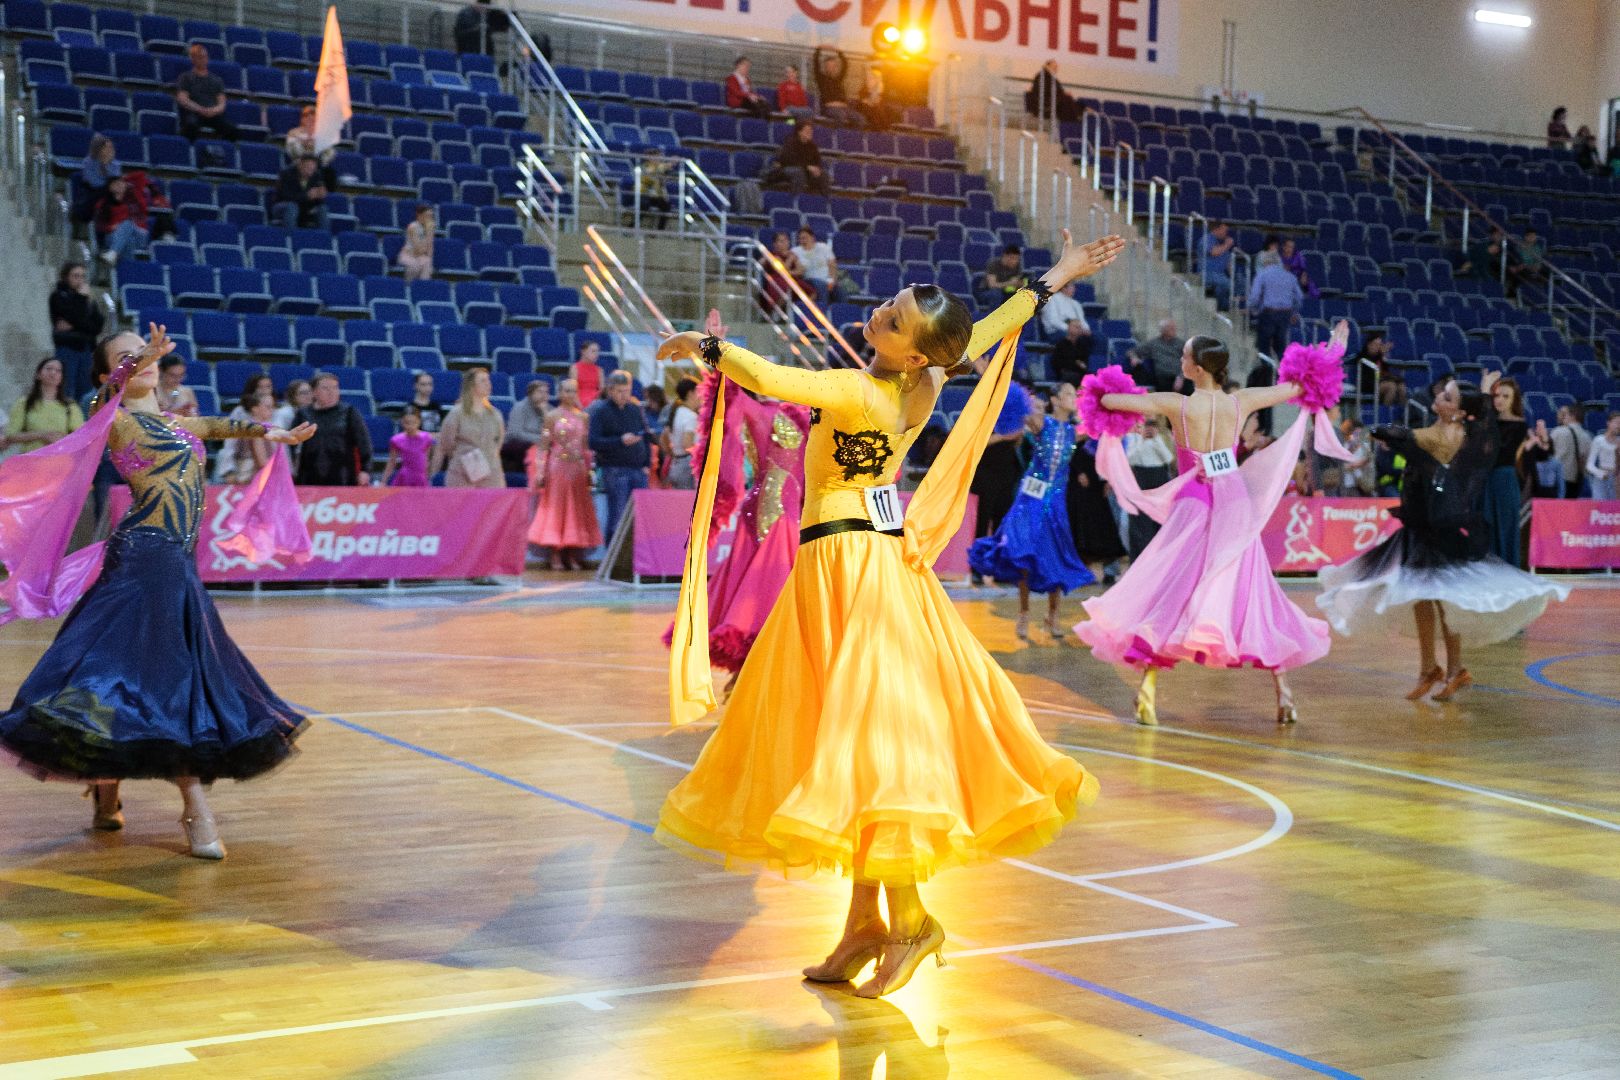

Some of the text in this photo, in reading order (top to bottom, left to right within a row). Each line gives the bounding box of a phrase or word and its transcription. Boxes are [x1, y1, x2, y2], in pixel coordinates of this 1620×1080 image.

[795, 0, 1158, 62] ЬНЕЕ!
[1209, 451, 1231, 471] 133
[301, 497, 379, 525] убок
[873, 490, 894, 523] 117
[311, 528, 440, 562] Драйва
